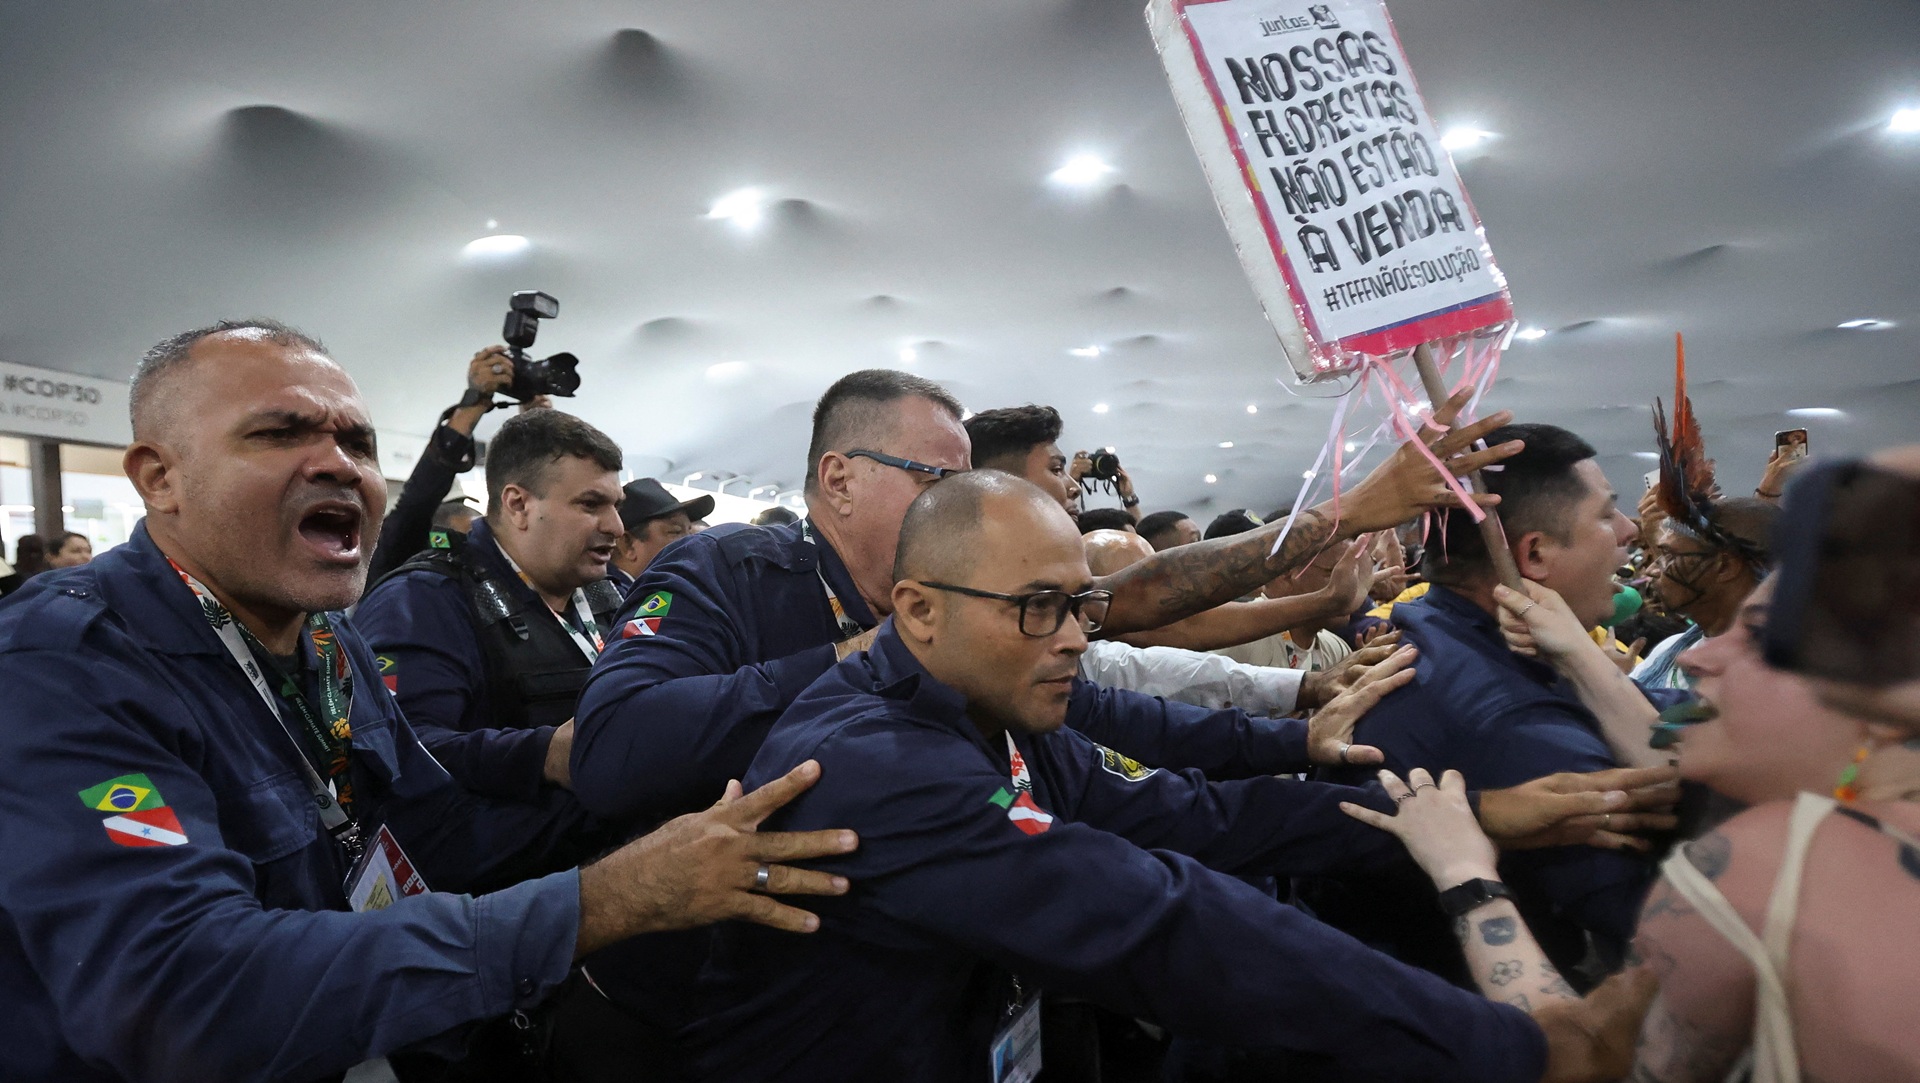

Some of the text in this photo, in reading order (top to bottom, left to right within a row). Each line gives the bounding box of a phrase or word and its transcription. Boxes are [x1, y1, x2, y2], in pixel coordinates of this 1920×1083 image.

[1259, 15, 1310, 37] juntos
[1224, 30, 1397, 104] NOSSAS
[1246, 80, 1419, 158] FLORESTAS
[1269, 126, 1440, 215] NÃO ESTÃO
[1294, 186, 1466, 273] À VENDA
